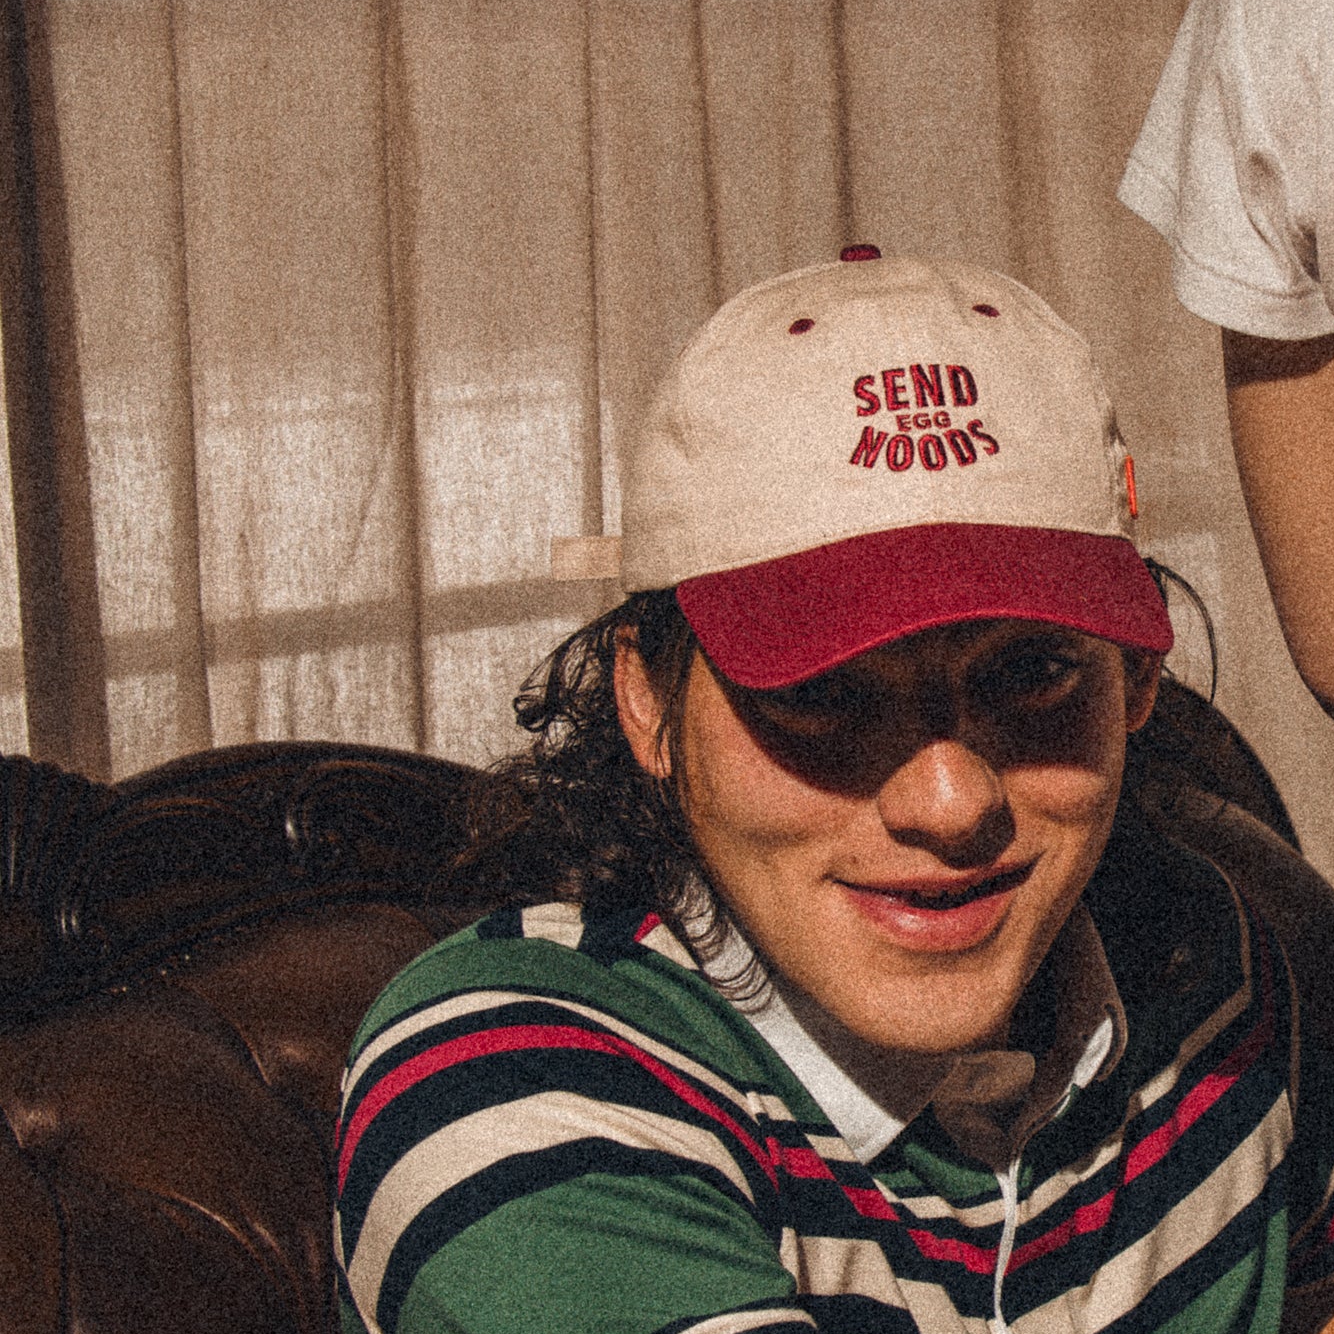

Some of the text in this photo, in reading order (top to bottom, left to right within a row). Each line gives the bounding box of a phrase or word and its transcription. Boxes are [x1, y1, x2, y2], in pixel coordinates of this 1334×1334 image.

[853, 363, 979, 417] SEND
[849, 419, 1000, 472] NOODS
[896, 411, 951, 432] EGG
